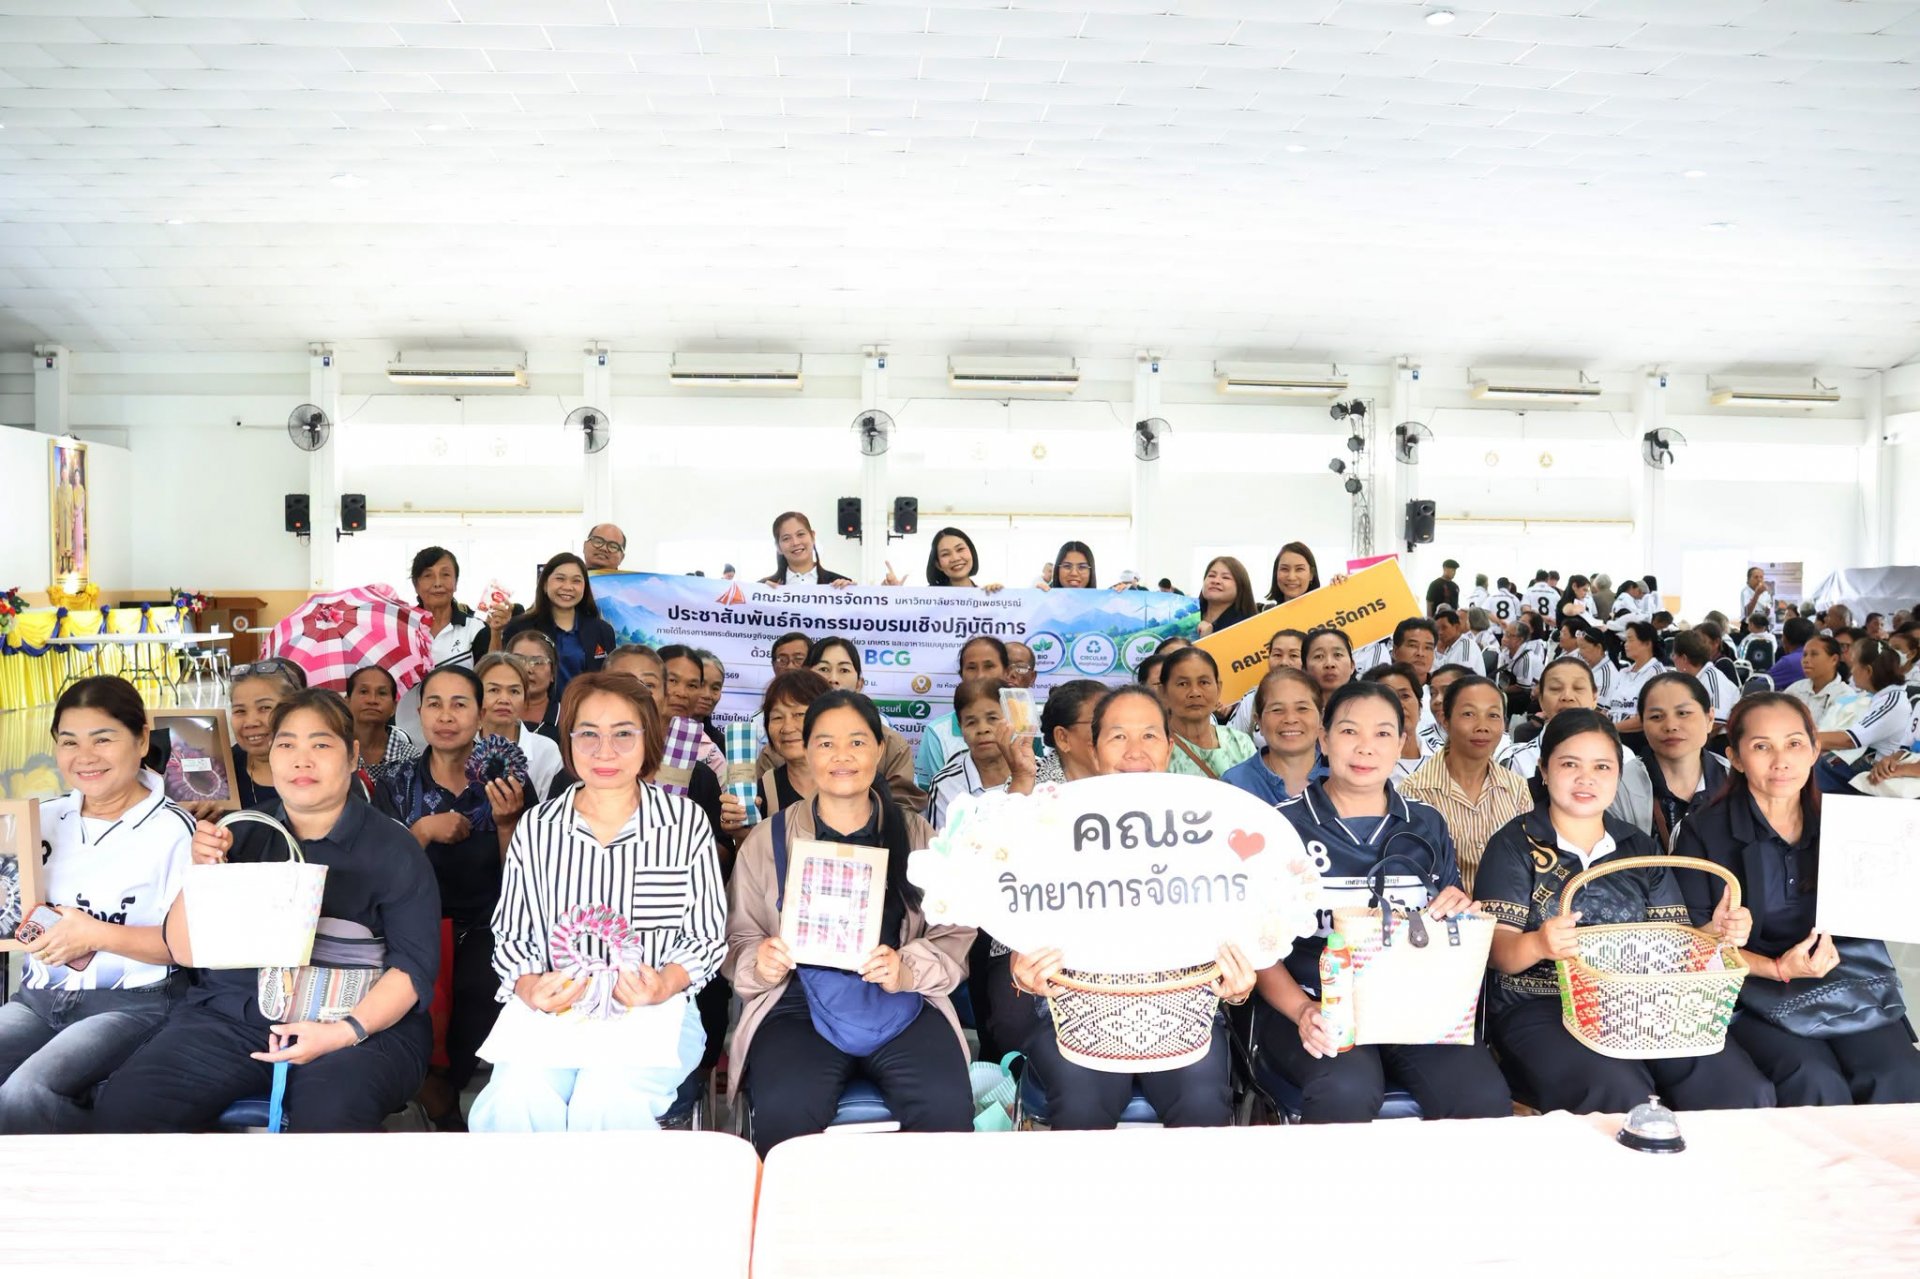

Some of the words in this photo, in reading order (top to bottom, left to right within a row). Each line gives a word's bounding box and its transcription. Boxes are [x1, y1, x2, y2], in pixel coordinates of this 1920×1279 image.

[752, 592, 888, 606] คณะวิทยาการจัดการ
[895, 596, 1022, 609] มหาวิทยาลัยราชภัฏเพชรบูรณ์
[1538, 597, 1549, 615] 8
[1496, 601, 1509, 619] 8
[668, 605, 1026, 638] ประชาสัมพันธ์กิจกรรมอบรมเชิงปฏิบัติการ
[864, 649, 911, 666] BCG
[724, 672, 740, 680] 569
[915, 704, 925, 716] 2
[1073, 808, 1213, 852] คณะ
[1306, 840, 1332, 873] 8
[999, 863, 1249, 913] วิทยาการจัดการ
